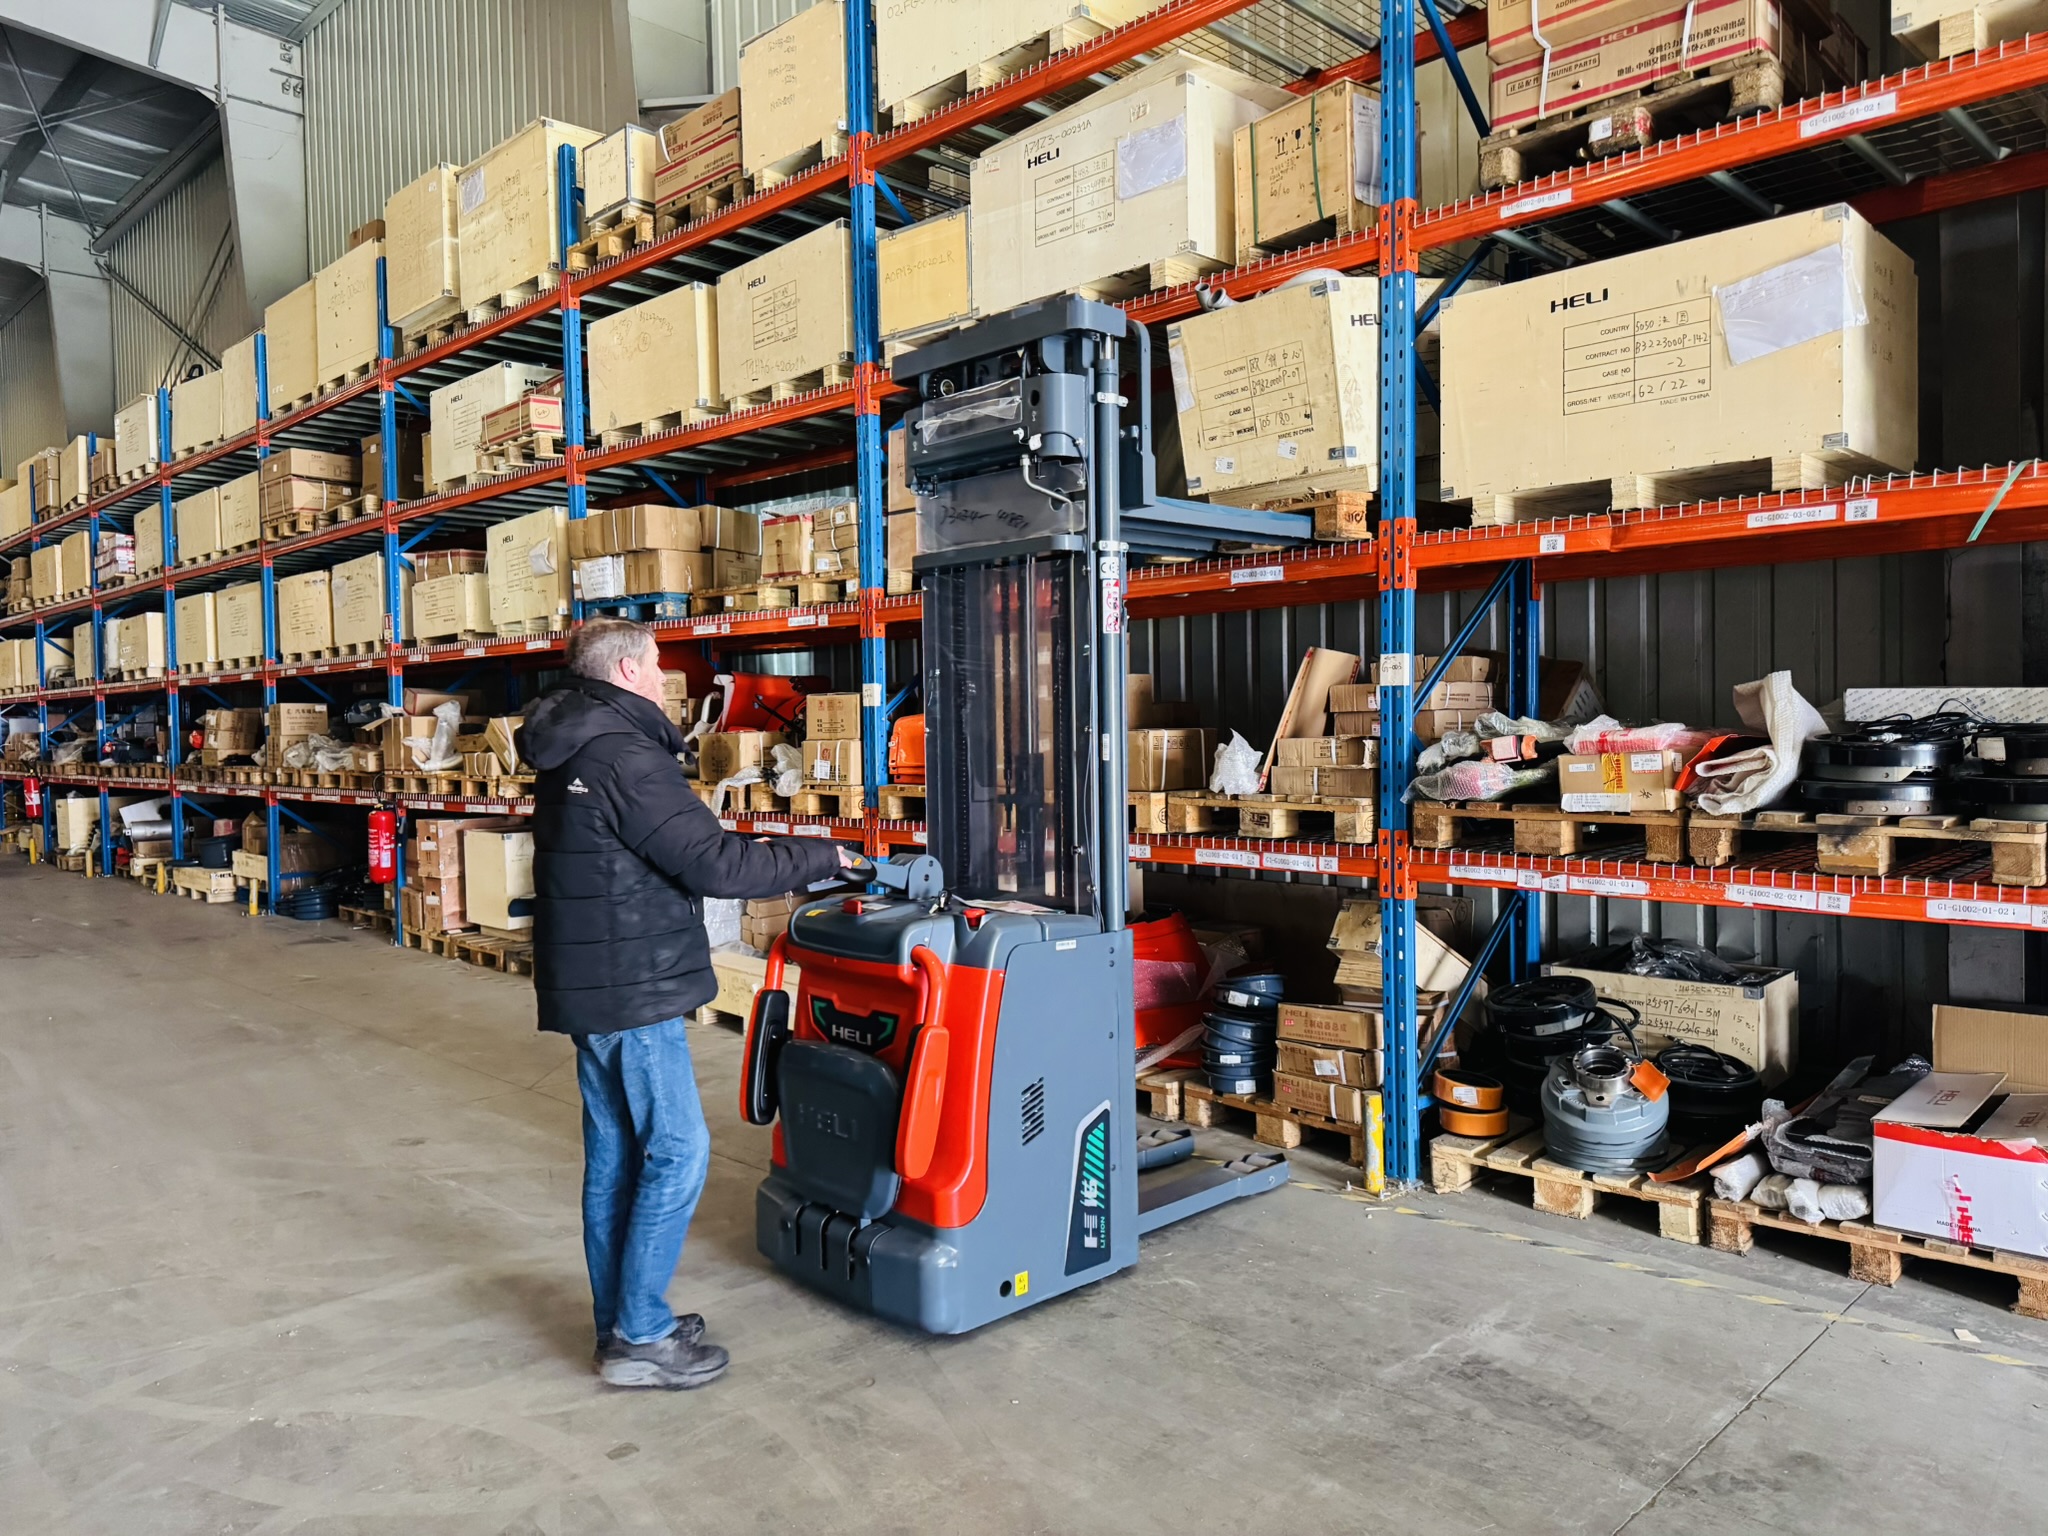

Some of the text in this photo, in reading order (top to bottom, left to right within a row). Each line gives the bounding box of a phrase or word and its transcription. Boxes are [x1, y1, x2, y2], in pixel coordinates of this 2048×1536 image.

[1600, 25, 1639, 46] HELI
[1573, 57, 1597, 70] PARTS
[1027, 147, 1060, 169] HELI
[747, 275, 766, 290] HELI
[1550, 287, 1609, 314] HELI
[1350, 313, 1381, 326] HEL
[1600, 324, 1630, 336] COUNTRY
[1585, 350, 1618, 361] CONTRACT
[1223, 365, 1246, 377] COUNTRY
[1602, 370, 1619, 378] CASE
[450, 394, 464, 404] HELI
[1214, 389, 1240, 400] CONTRACT
[1607, 390, 1632, 400] WEIGHT
[1659, 398, 1679, 407] MADE
[1689, 391, 1710, 401] CHINA
[1229, 409, 1241, 417] CASE
[502, 534, 514, 545] HELI
[1285, 1008, 1309, 1018] HELI
[831, 1023, 873, 1046] HELI
[1284, 1045, 1308, 1056] HELI
[1277, 1076, 1300, 1087] HELI
[1936, 1219, 1954, 1228] MADE
